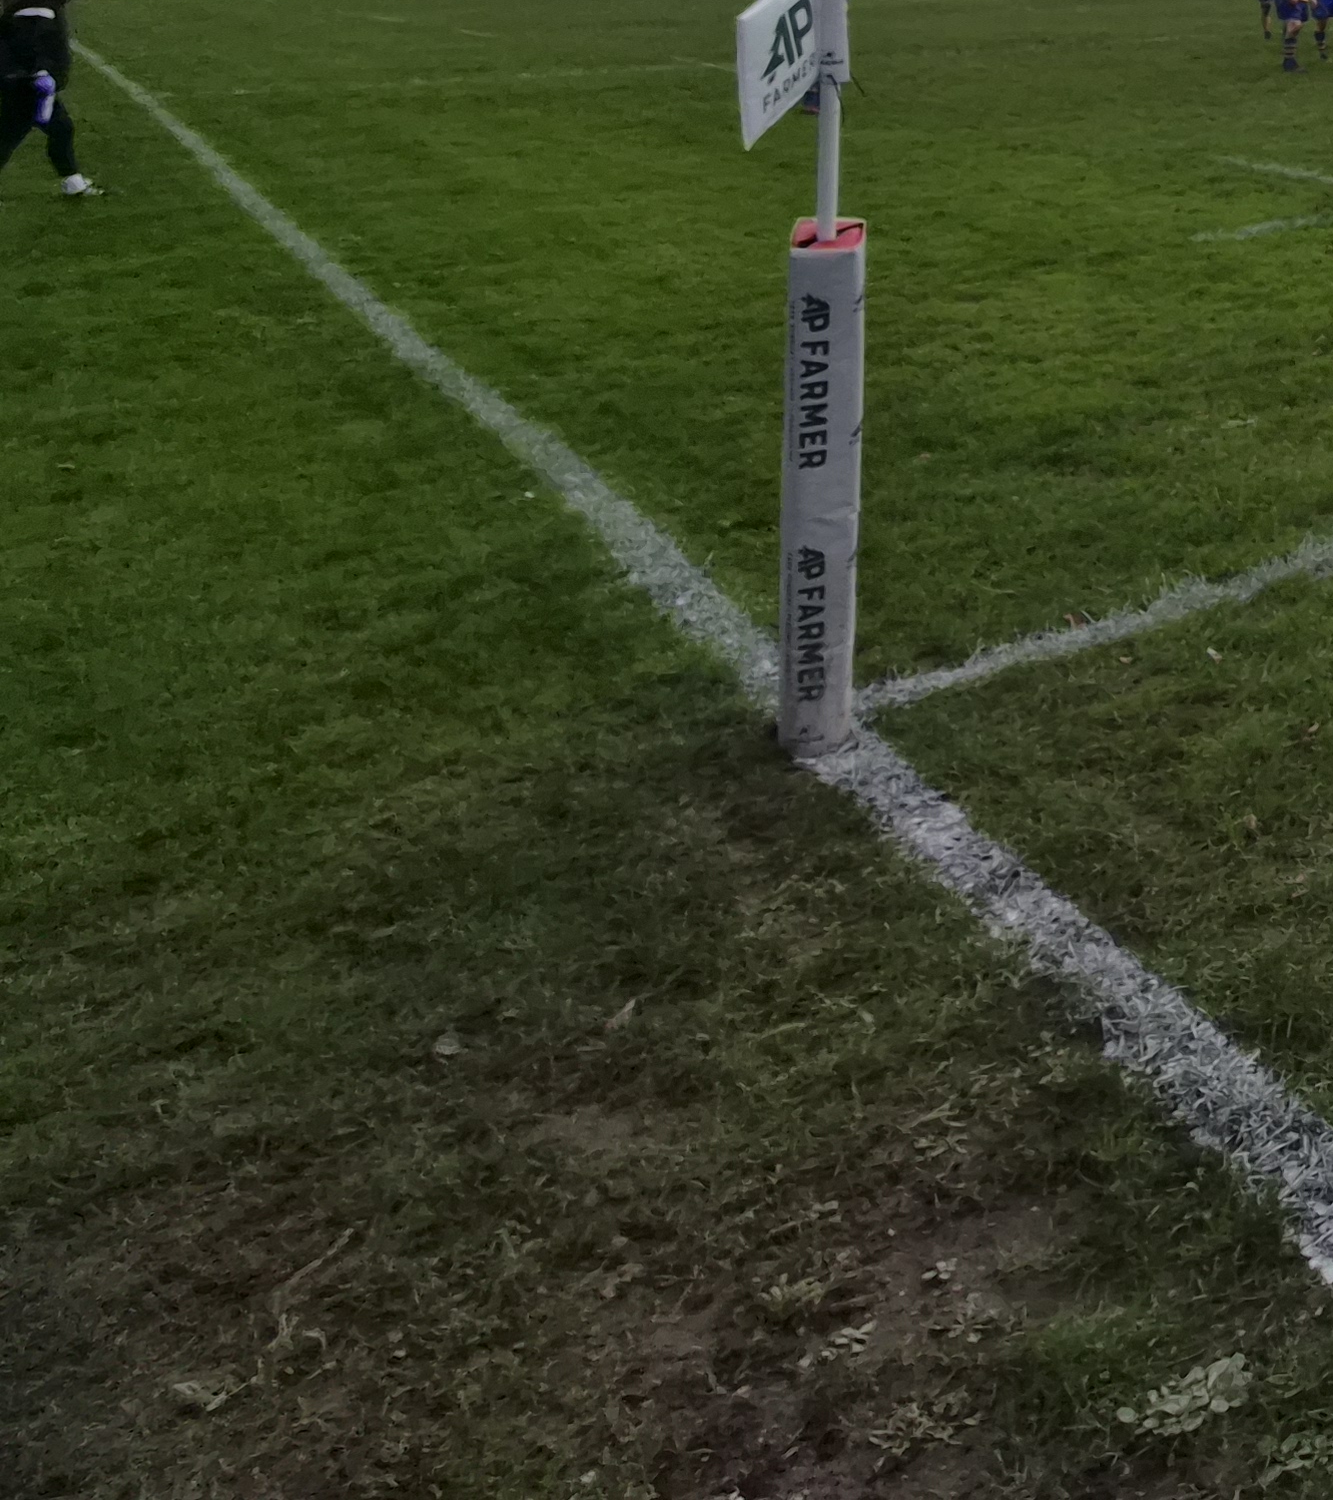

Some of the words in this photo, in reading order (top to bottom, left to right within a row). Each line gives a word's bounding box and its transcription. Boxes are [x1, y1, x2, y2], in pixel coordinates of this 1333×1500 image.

[801, 293, 831, 333] AP
[799, 340, 830, 470] FARMER
[798, 545, 826, 581] AP
[797, 585, 826, 701] FARMER
